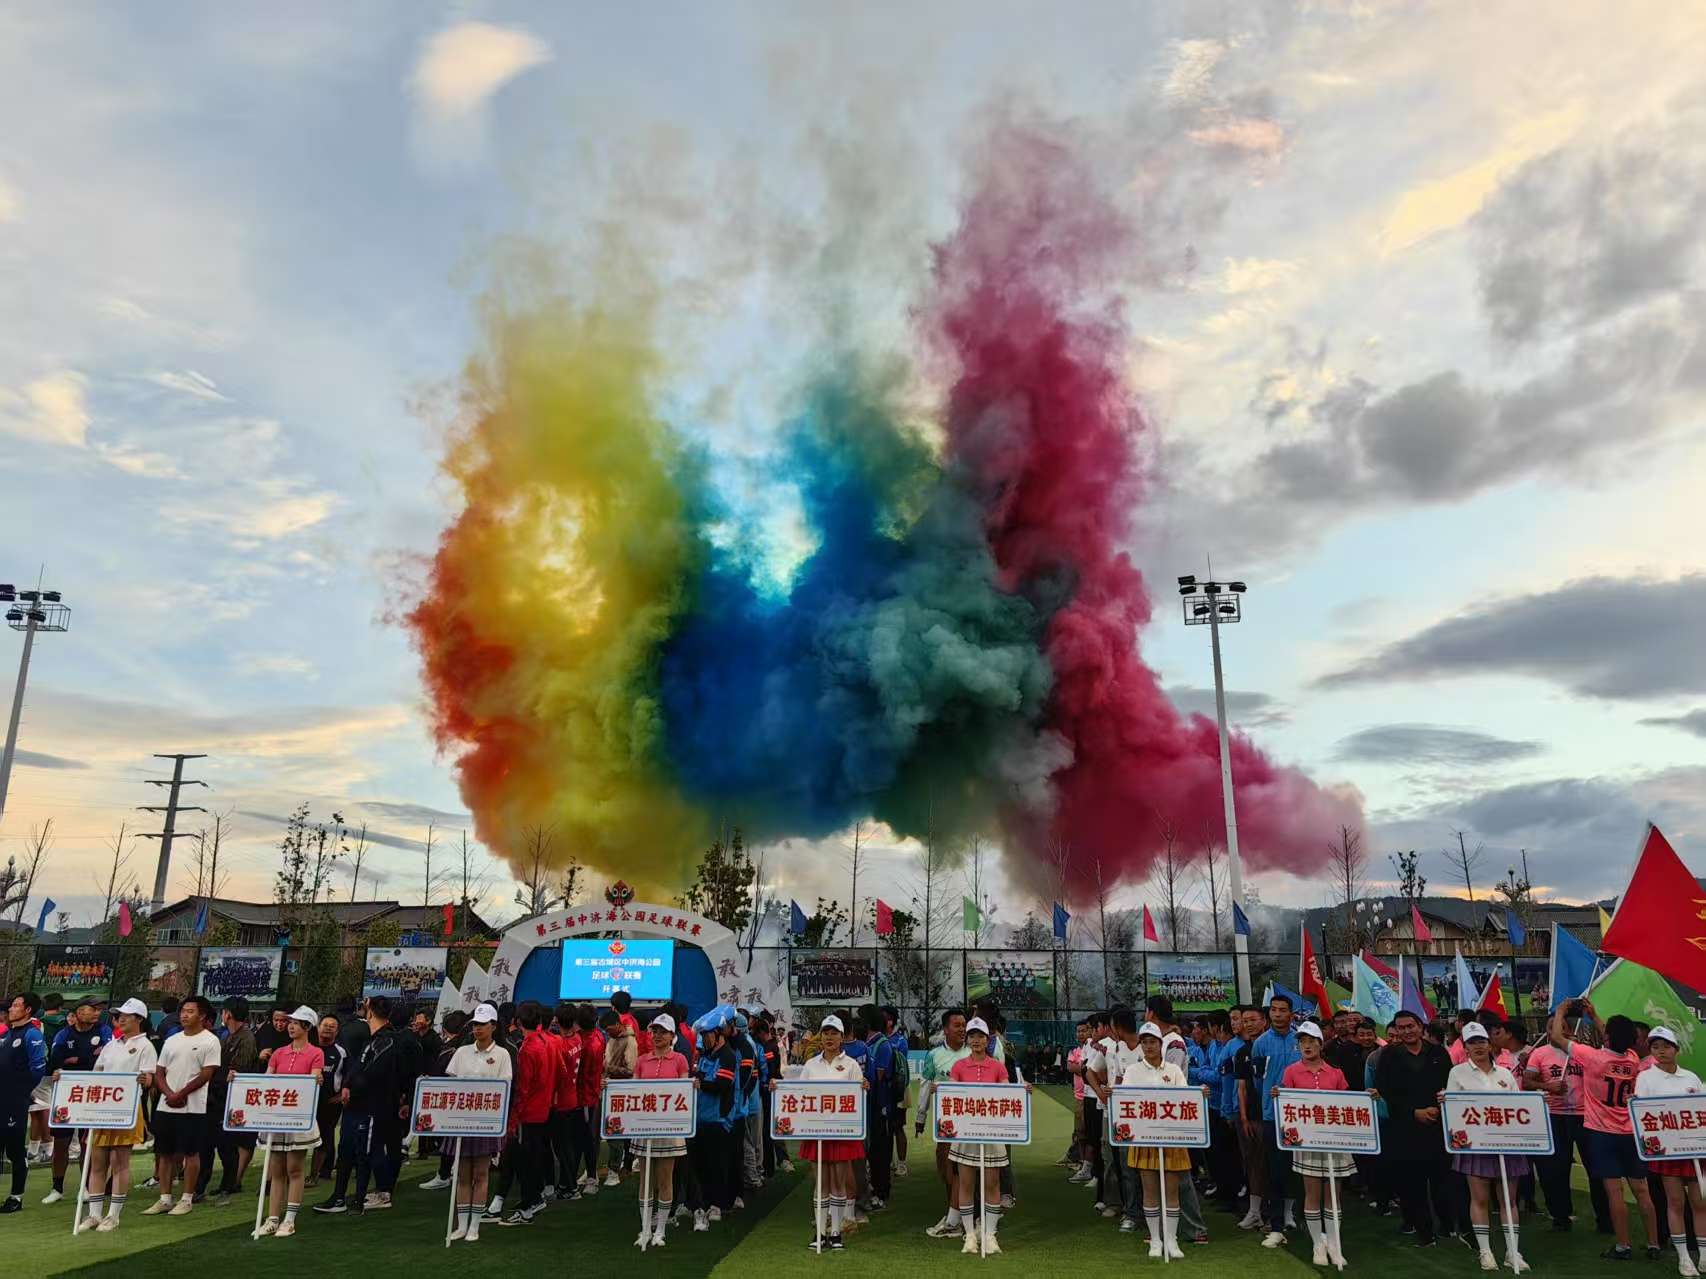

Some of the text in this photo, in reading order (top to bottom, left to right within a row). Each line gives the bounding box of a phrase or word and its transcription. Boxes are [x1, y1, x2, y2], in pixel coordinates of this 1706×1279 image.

[536, 911, 702, 937] 第三届中济海公园足球联赛
[68, 1085, 124, 1104] 启博FC
[245, 1088, 299, 1107] 欧帝丝
[610, 1093, 689, 1112] 丽江饿了么
[781, 1094, 857, 1113] 沧江同盟
[941, 1096, 1023, 1118] 普取坞哈布萨特
[1119, 1100, 1198, 1120] 玉湖文旅
[1283, 1103, 1371, 1127] 东中鲁美道畅
[1462, 1106, 1531, 1127] 公海FC
